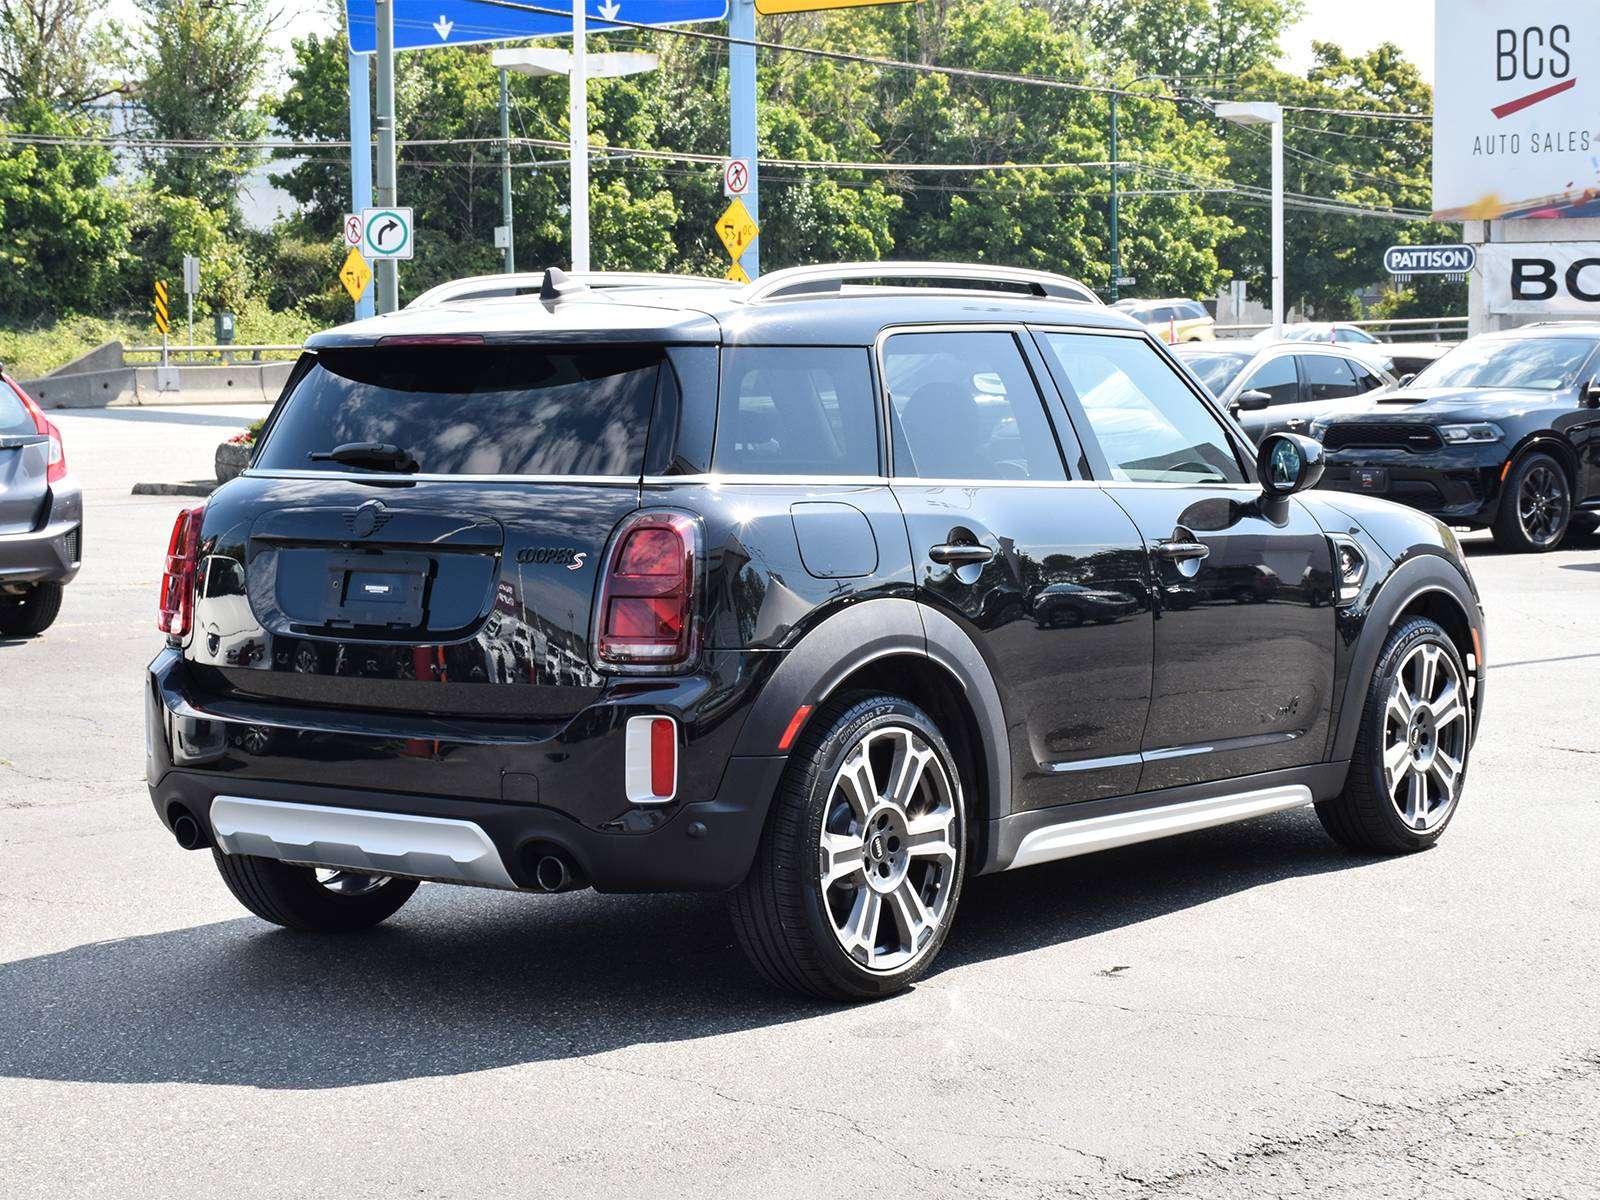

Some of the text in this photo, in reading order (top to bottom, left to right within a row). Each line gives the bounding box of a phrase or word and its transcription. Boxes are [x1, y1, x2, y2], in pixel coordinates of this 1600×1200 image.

[1497, 24, 1570, 82] BCS
[1473, 130, 1590, 156] AUTO SALES
[1391, 250, 1468, 268] PATTISON
[515, 547, 587, 571] COOPER S
[876, 704, 895, 715] P7
